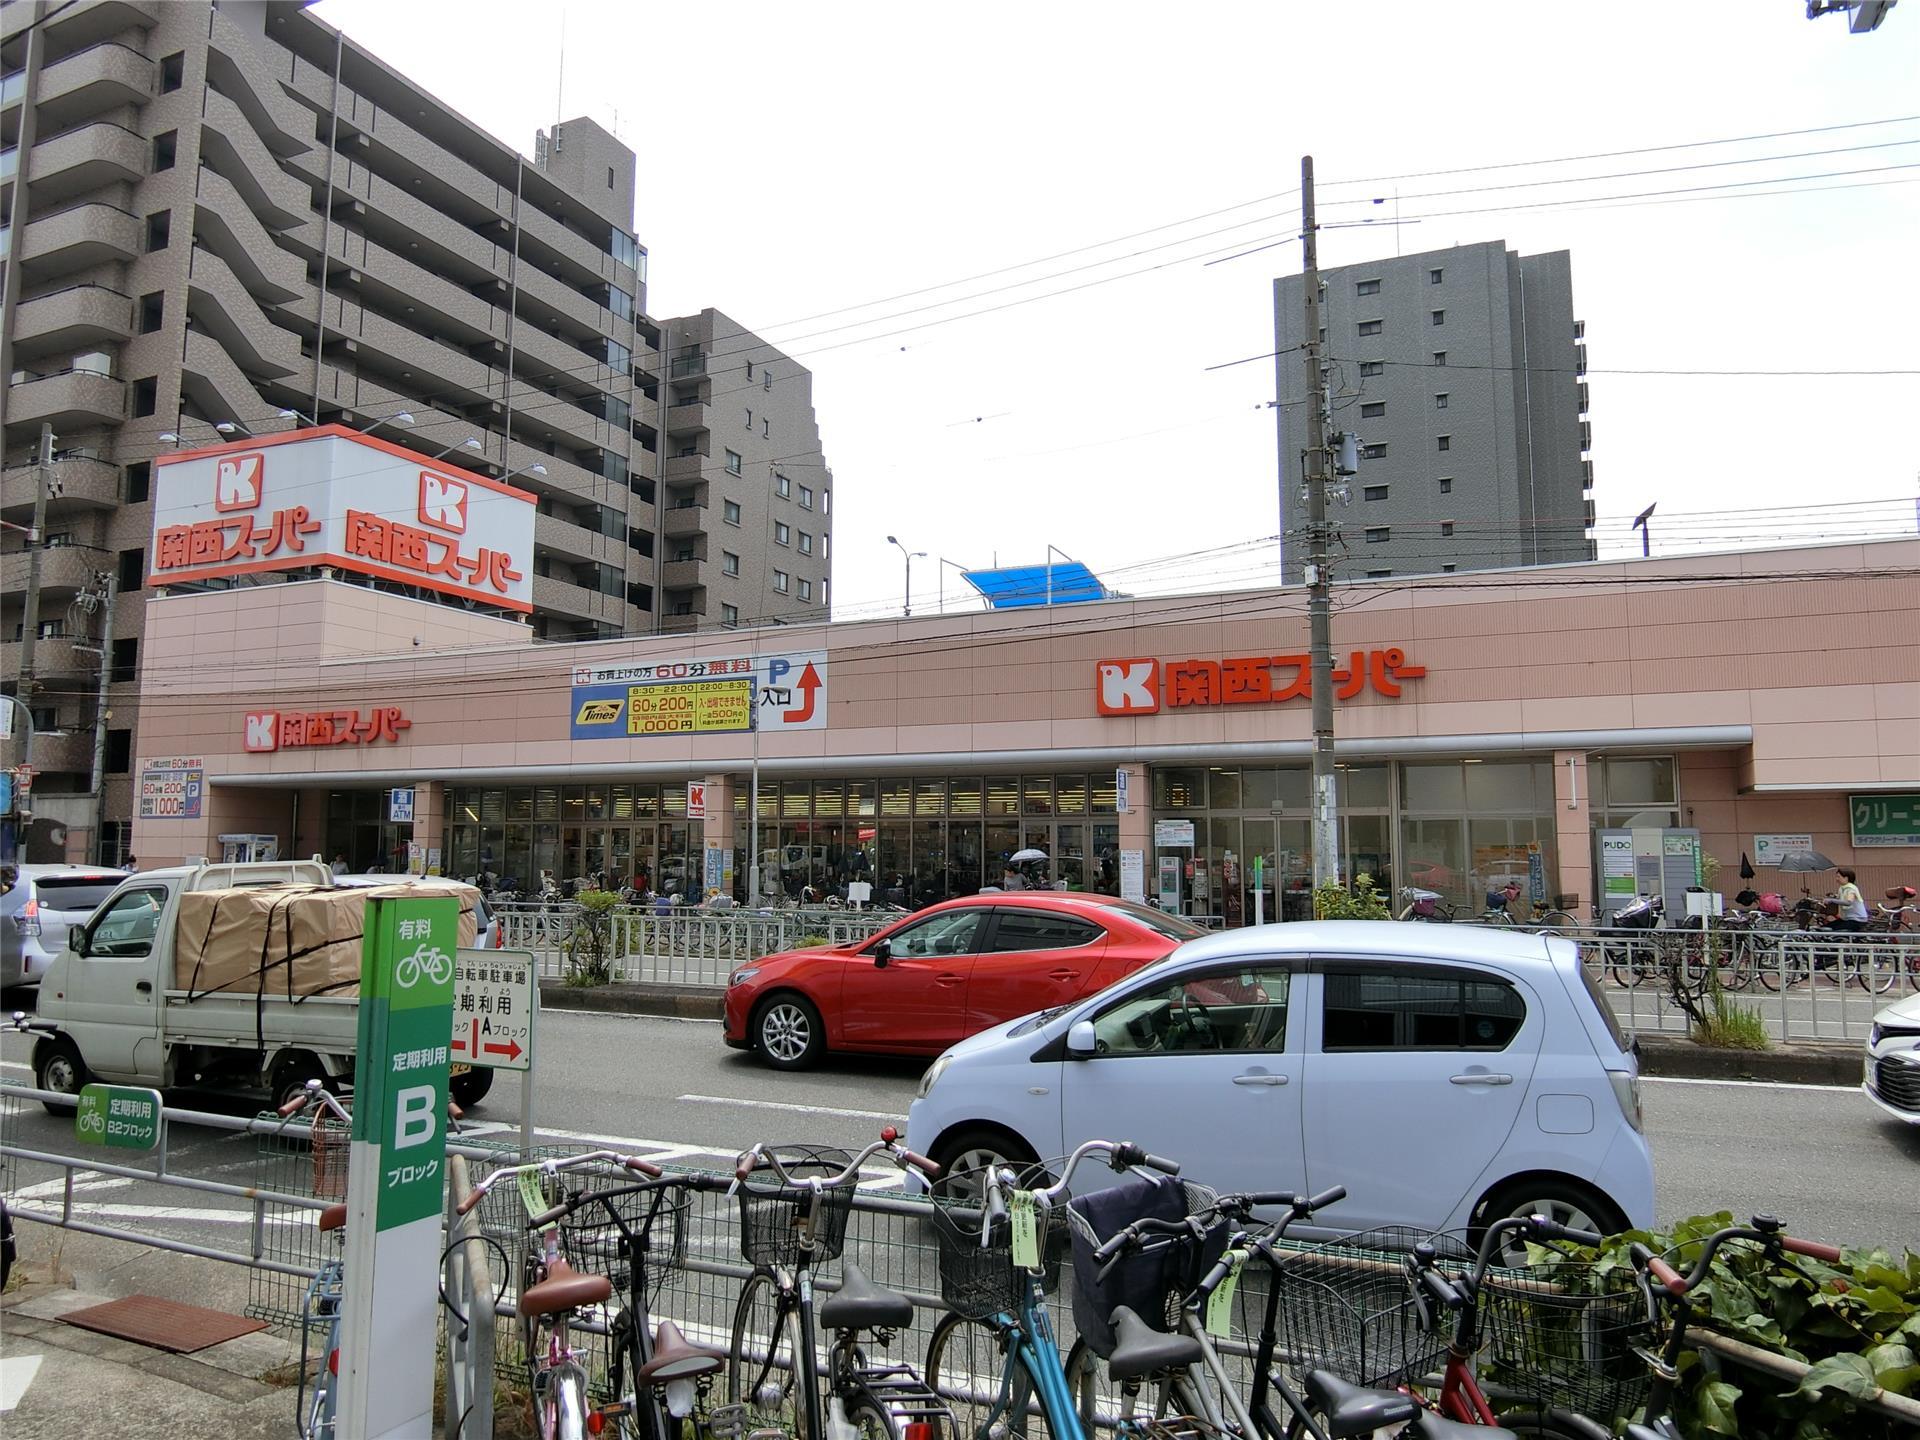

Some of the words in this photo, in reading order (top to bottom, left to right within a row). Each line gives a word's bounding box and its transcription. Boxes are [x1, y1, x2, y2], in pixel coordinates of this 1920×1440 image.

[156, 506, 321, 569] 関西スーパー
[345, 509, 522, 593] 関西スーパー
[769, 659, 790, 684] P
[761, 688, 791, 706] 入口
[585, 709, 615, 721] Times
[279, 706, 411, 746] 関西スーパー
[633, 719, 693, 732] 1,000円
[189, 784, 198, 796] P
[1604, 841, 1631, 849] PUDO
[399, 918, 432, 940] 有料
[455, 967, 526, 985] 自転車駐車場
[453, 995, 511, 1015] 期利用
[393, 1046, 447, 1072] 定期利用
[110, 1099, 152, 1118] 定期利用
[395, 1084, 436, 1150] B
[107, 1121, 153, 1138] B2ブロック
[388, 1160, 438, 1188] ブロック
